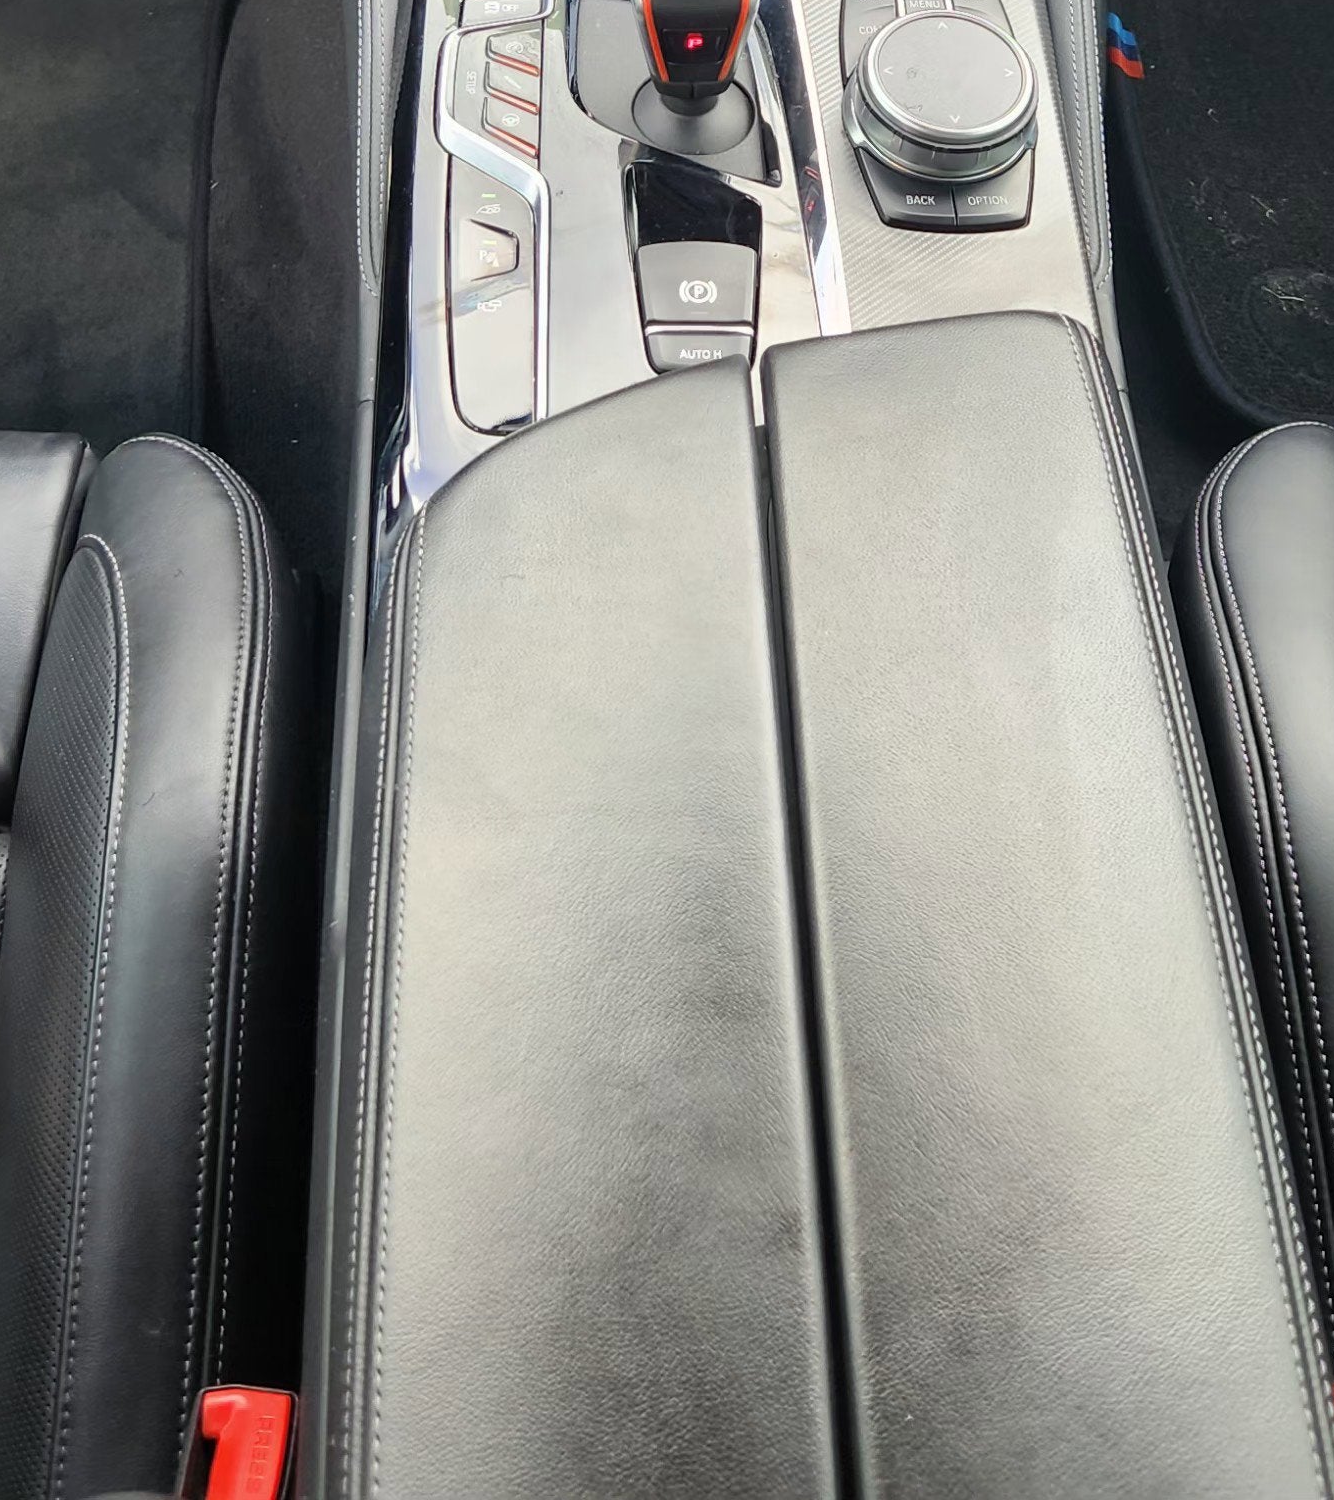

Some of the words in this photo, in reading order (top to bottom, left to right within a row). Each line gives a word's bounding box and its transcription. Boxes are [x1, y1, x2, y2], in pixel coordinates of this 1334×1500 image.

[501, 3, 519, 12] OFF
[908, 0, 940, 9] MENU
[466, 71, 477, 95] SETUP
[906, 194, 936, 206] BACK
[967, 195, 1008, 206] OPTION
[679, 348, 710, 360] AUTO
[713, 349, 723, 360] H
